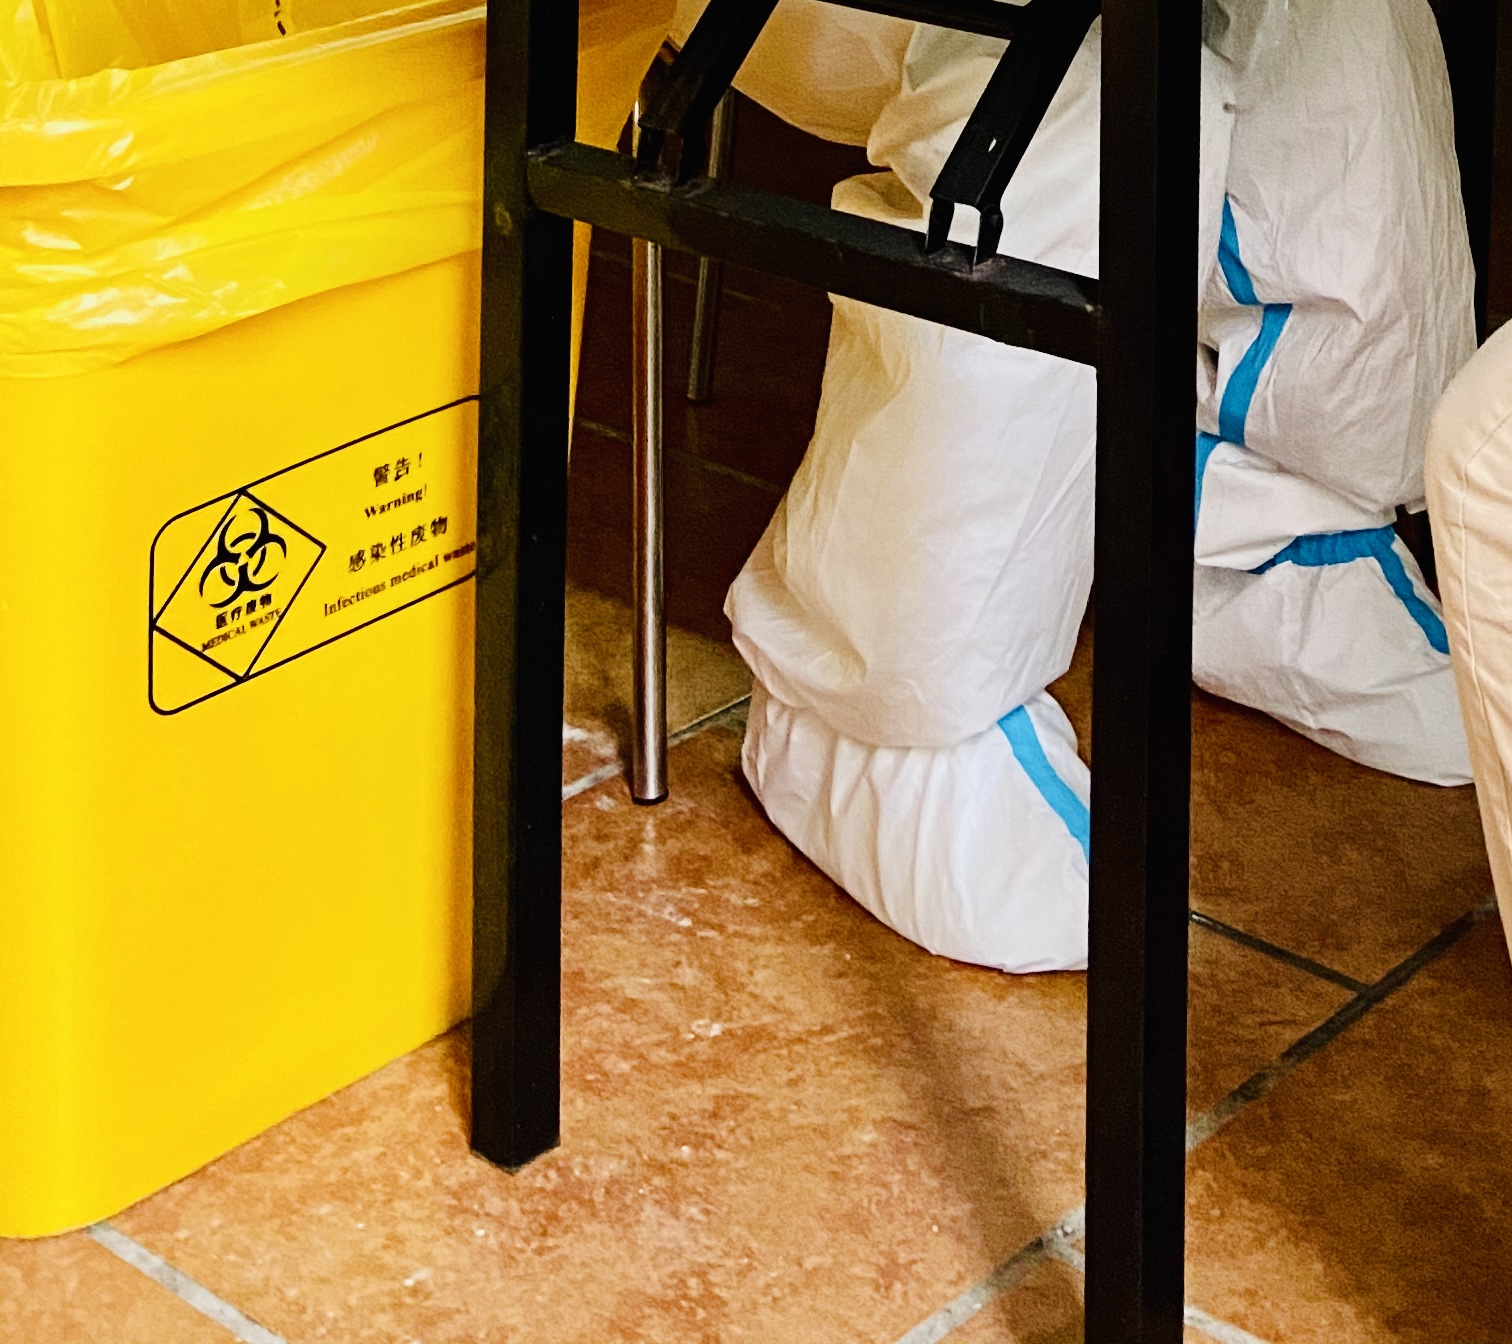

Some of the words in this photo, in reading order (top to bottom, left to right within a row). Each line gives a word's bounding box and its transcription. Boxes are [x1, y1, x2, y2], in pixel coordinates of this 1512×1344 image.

[364, 482, 428, 519] Warning!
[348, 515, 449, 574] 感染性废物
[323, 580, 387, 617] Infectious
[390, 554, 439, 588] medical
[215, 593, 272, 630] 医疗废物
[202, 624, 247, 653] MEDICAL
